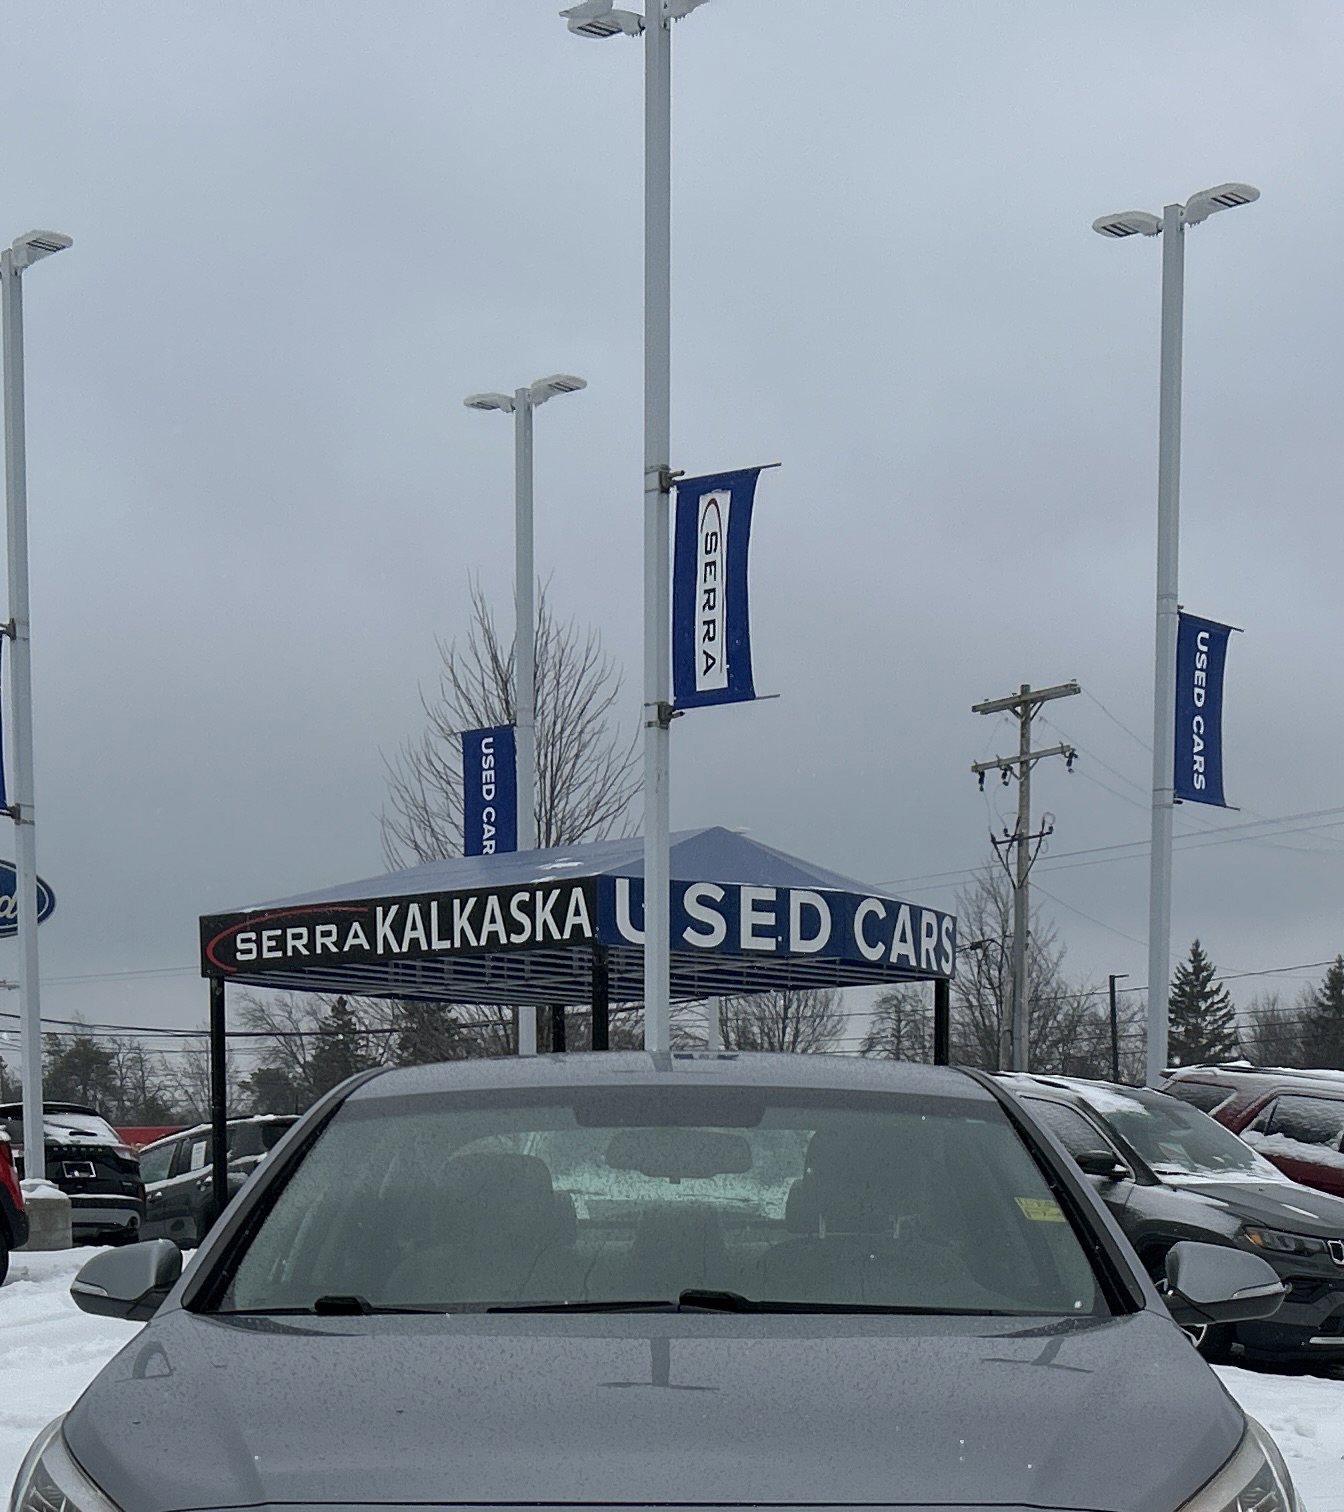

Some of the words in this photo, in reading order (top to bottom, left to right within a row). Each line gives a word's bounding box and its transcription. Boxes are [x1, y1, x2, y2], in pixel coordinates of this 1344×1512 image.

[702, 531, 718, 677] SERRA
[1193, 631, 1210, 708] USED
[481, 737, 496, 801] USED
[1192, 715, 1206, 791] CARS
[482, 806, 496, 856] CAR
[235, 921, 370, 961] SERRA
[375, 886, 593, 955] KALKASKA
[615, 877, 832, 953] USED
[854, 898, 954, 976] CARS
